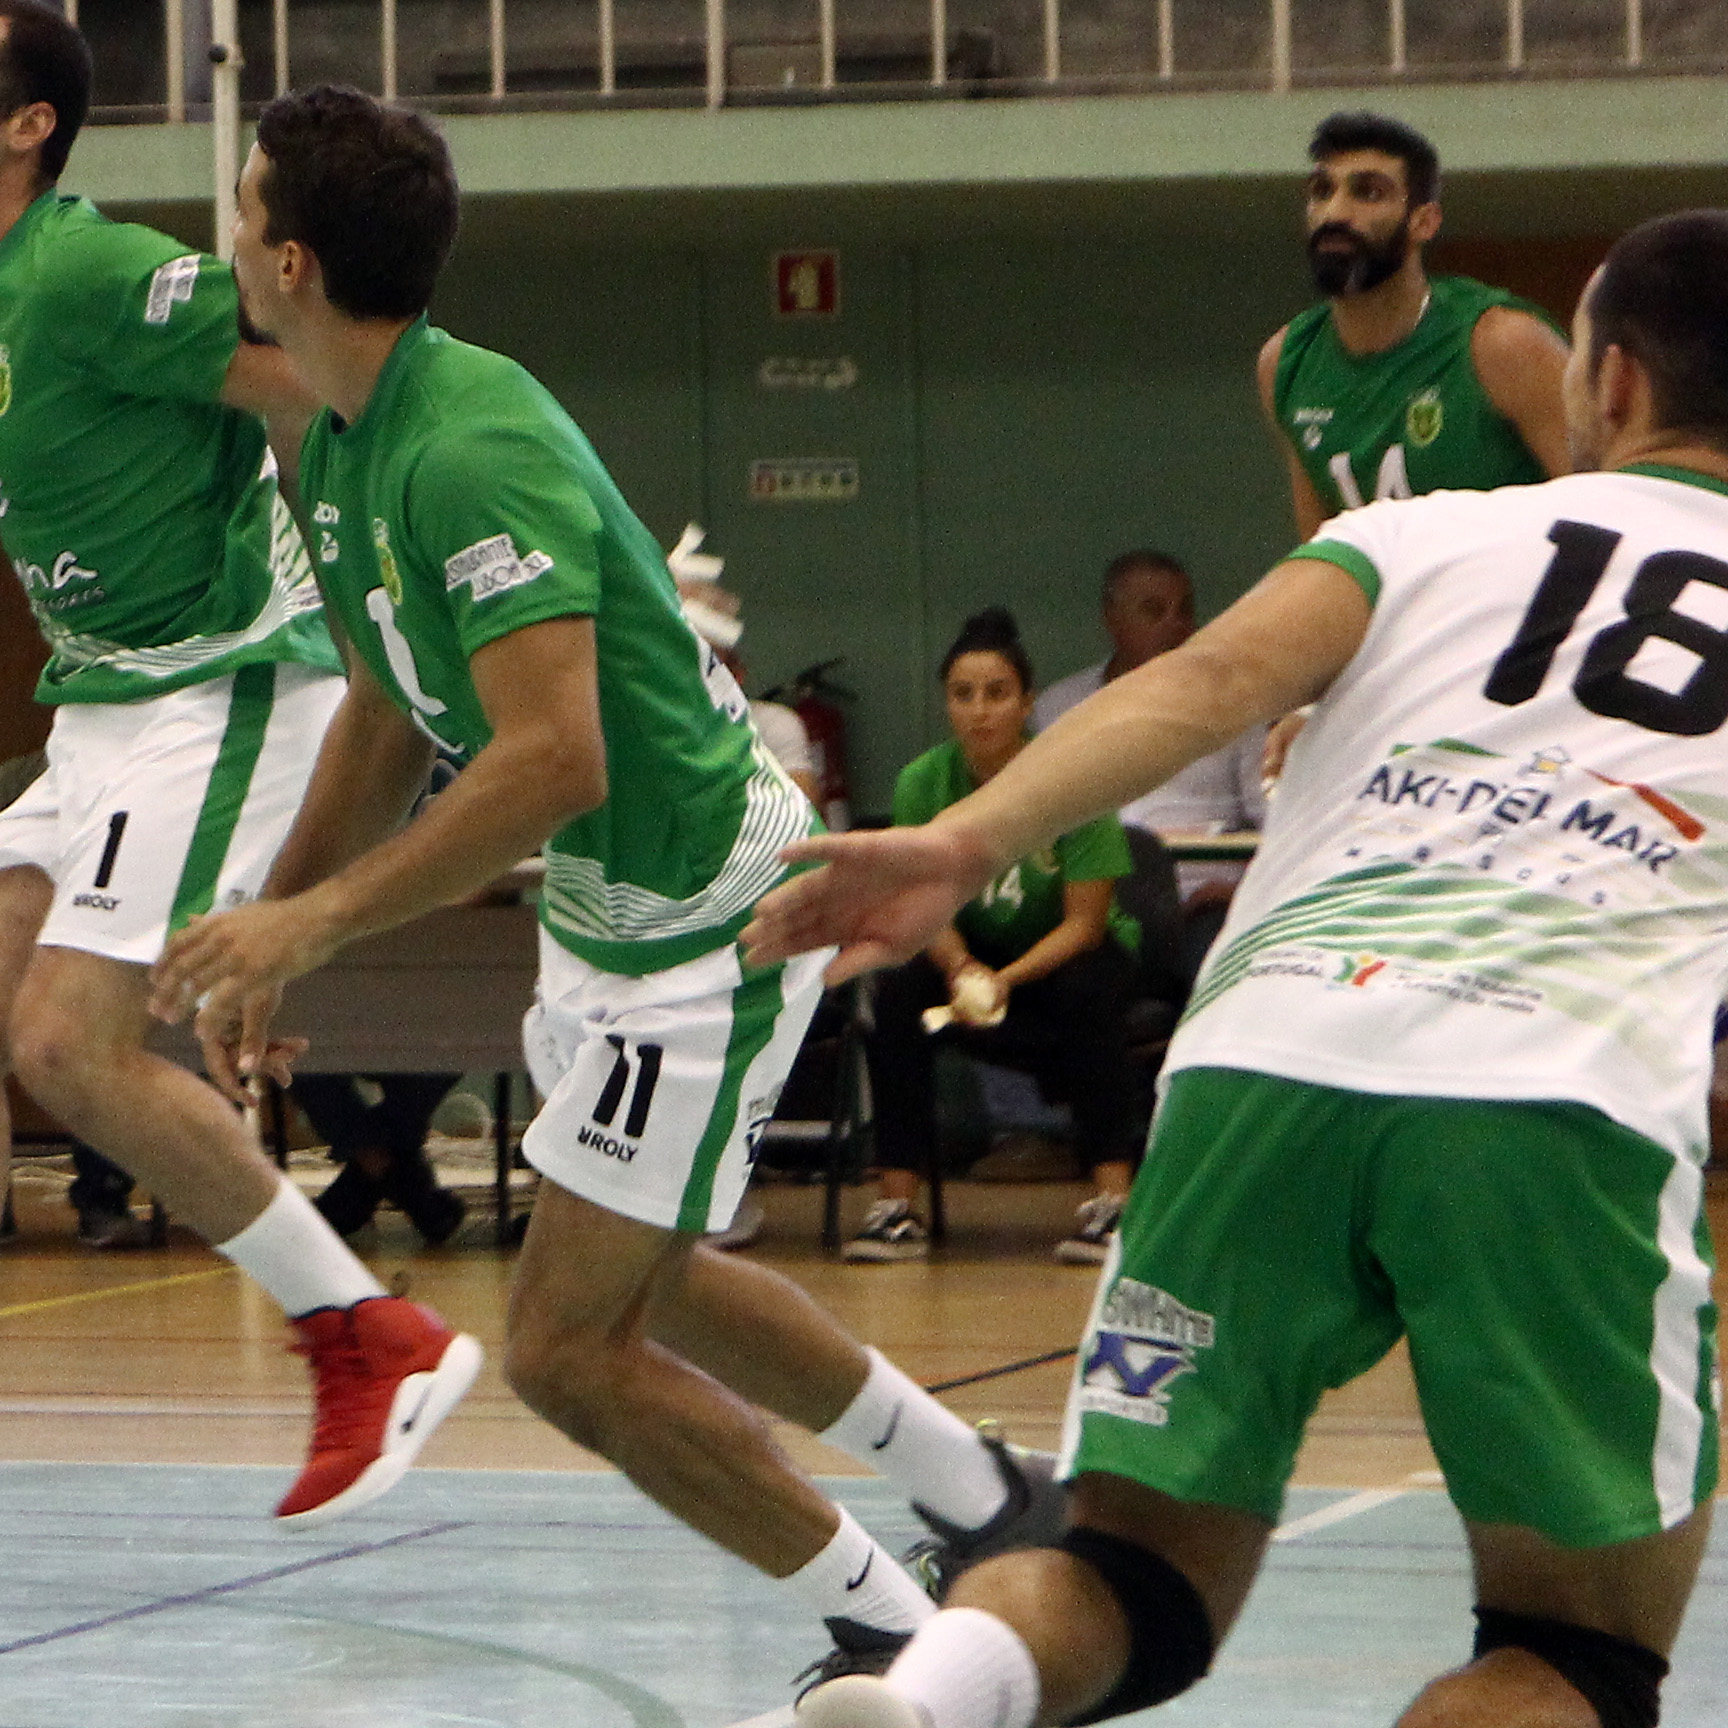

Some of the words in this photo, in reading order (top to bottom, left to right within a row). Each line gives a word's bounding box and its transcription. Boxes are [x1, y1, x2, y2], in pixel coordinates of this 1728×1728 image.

[1483, 519, 1728, 737] 18
[94, 810, 129, 889] 1
[1560, 799, 1680, 874] MAR
[592, 1033, 664, 1139] 11
